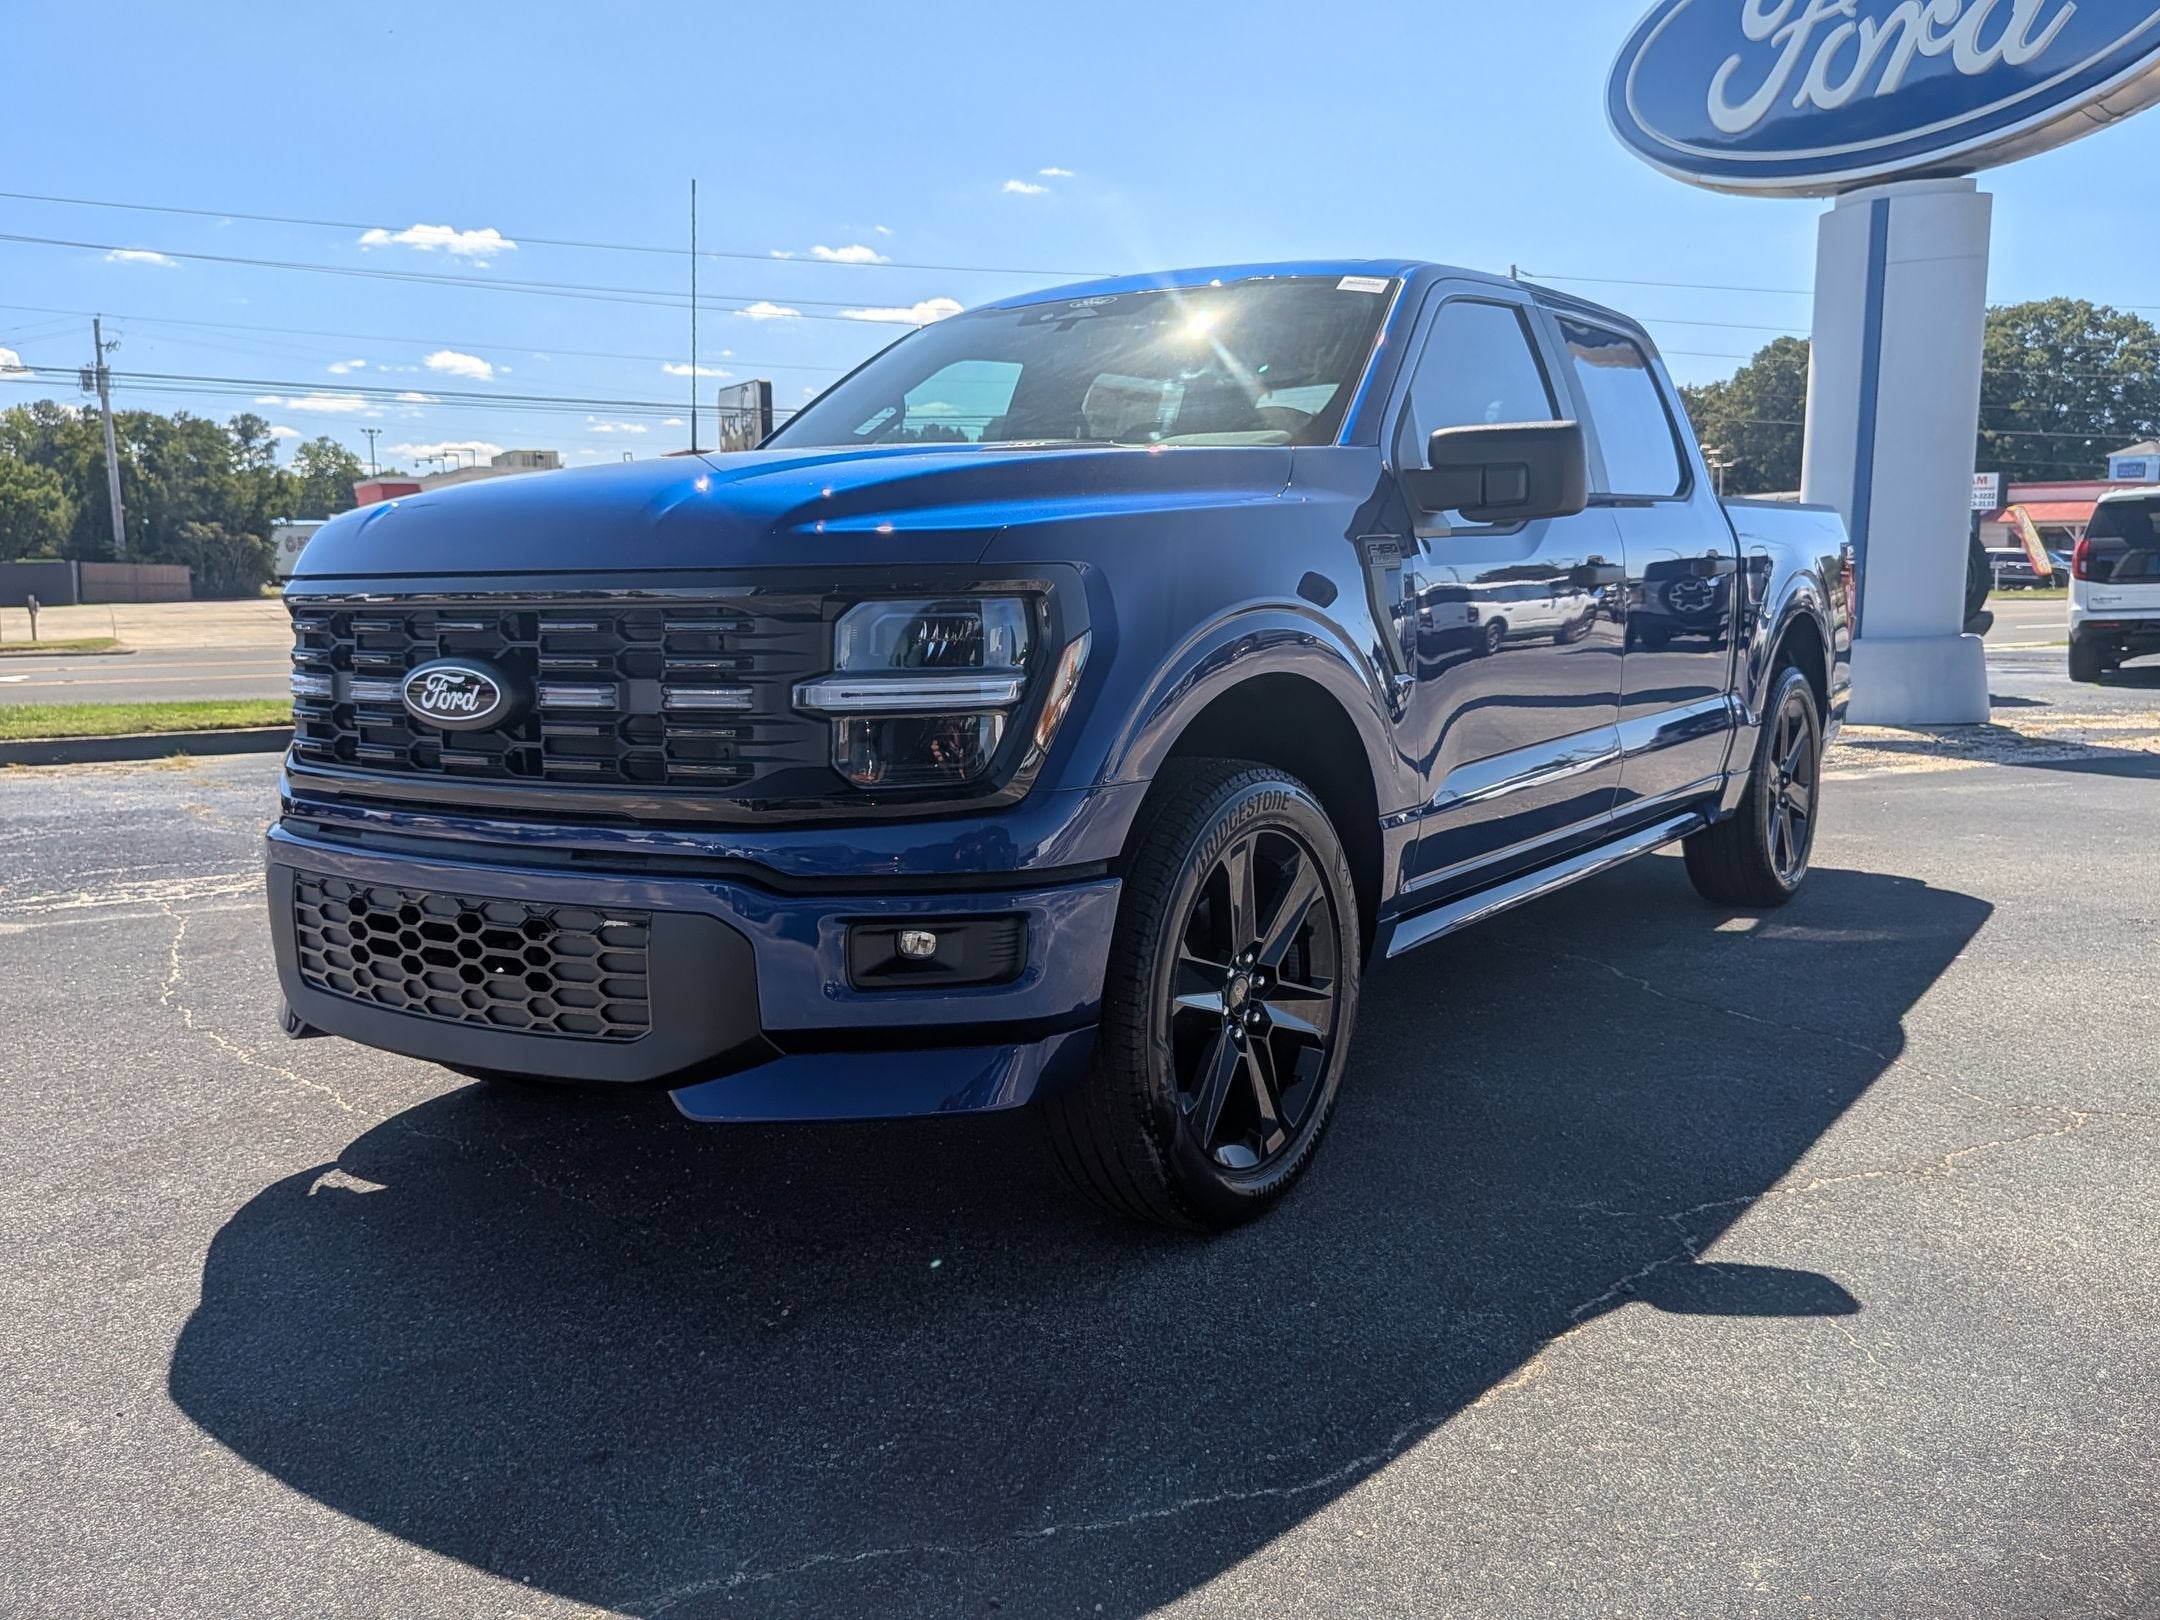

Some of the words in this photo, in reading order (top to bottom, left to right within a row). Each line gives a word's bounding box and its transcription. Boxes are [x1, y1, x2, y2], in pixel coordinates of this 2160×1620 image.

[1707, 0, 2077, 133] Ford
[721, 412, 739, 437] KFC
[421, 673, 480, 711] Ford
[1191, 790, 1290, 874] BRIDGESTONE
